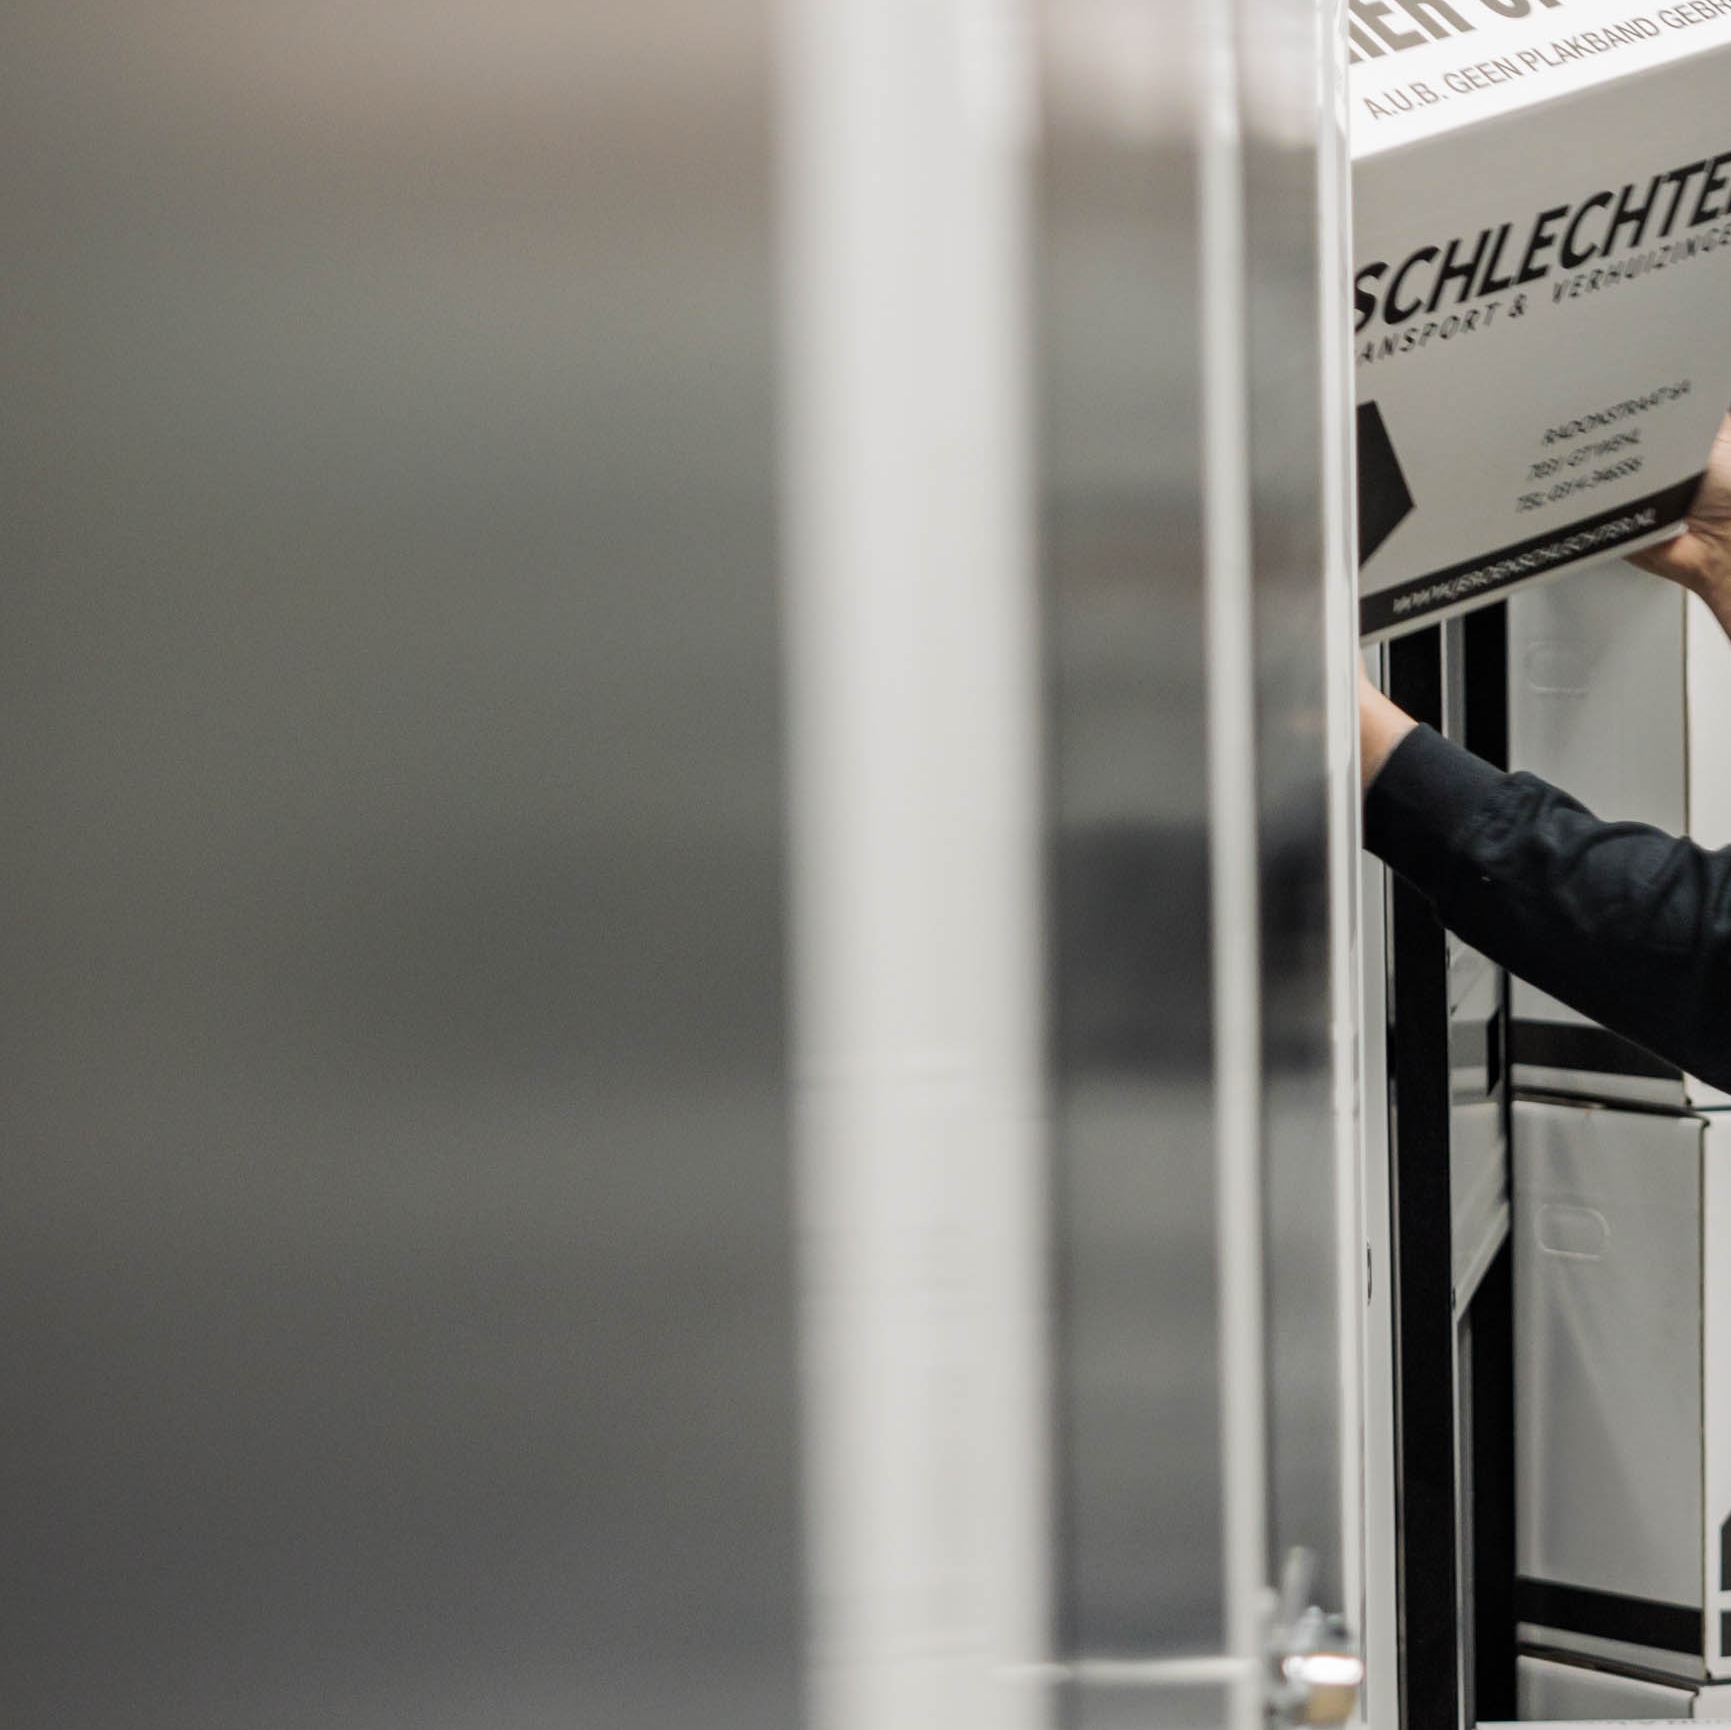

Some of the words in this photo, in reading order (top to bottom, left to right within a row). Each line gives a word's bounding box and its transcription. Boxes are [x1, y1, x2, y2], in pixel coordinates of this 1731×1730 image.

[1363, 83, 1447, 120] A.U.B.
[1443, 51, 1524, 95] GEEN
[1523, 16, 1660, 73] PLAKBAND
